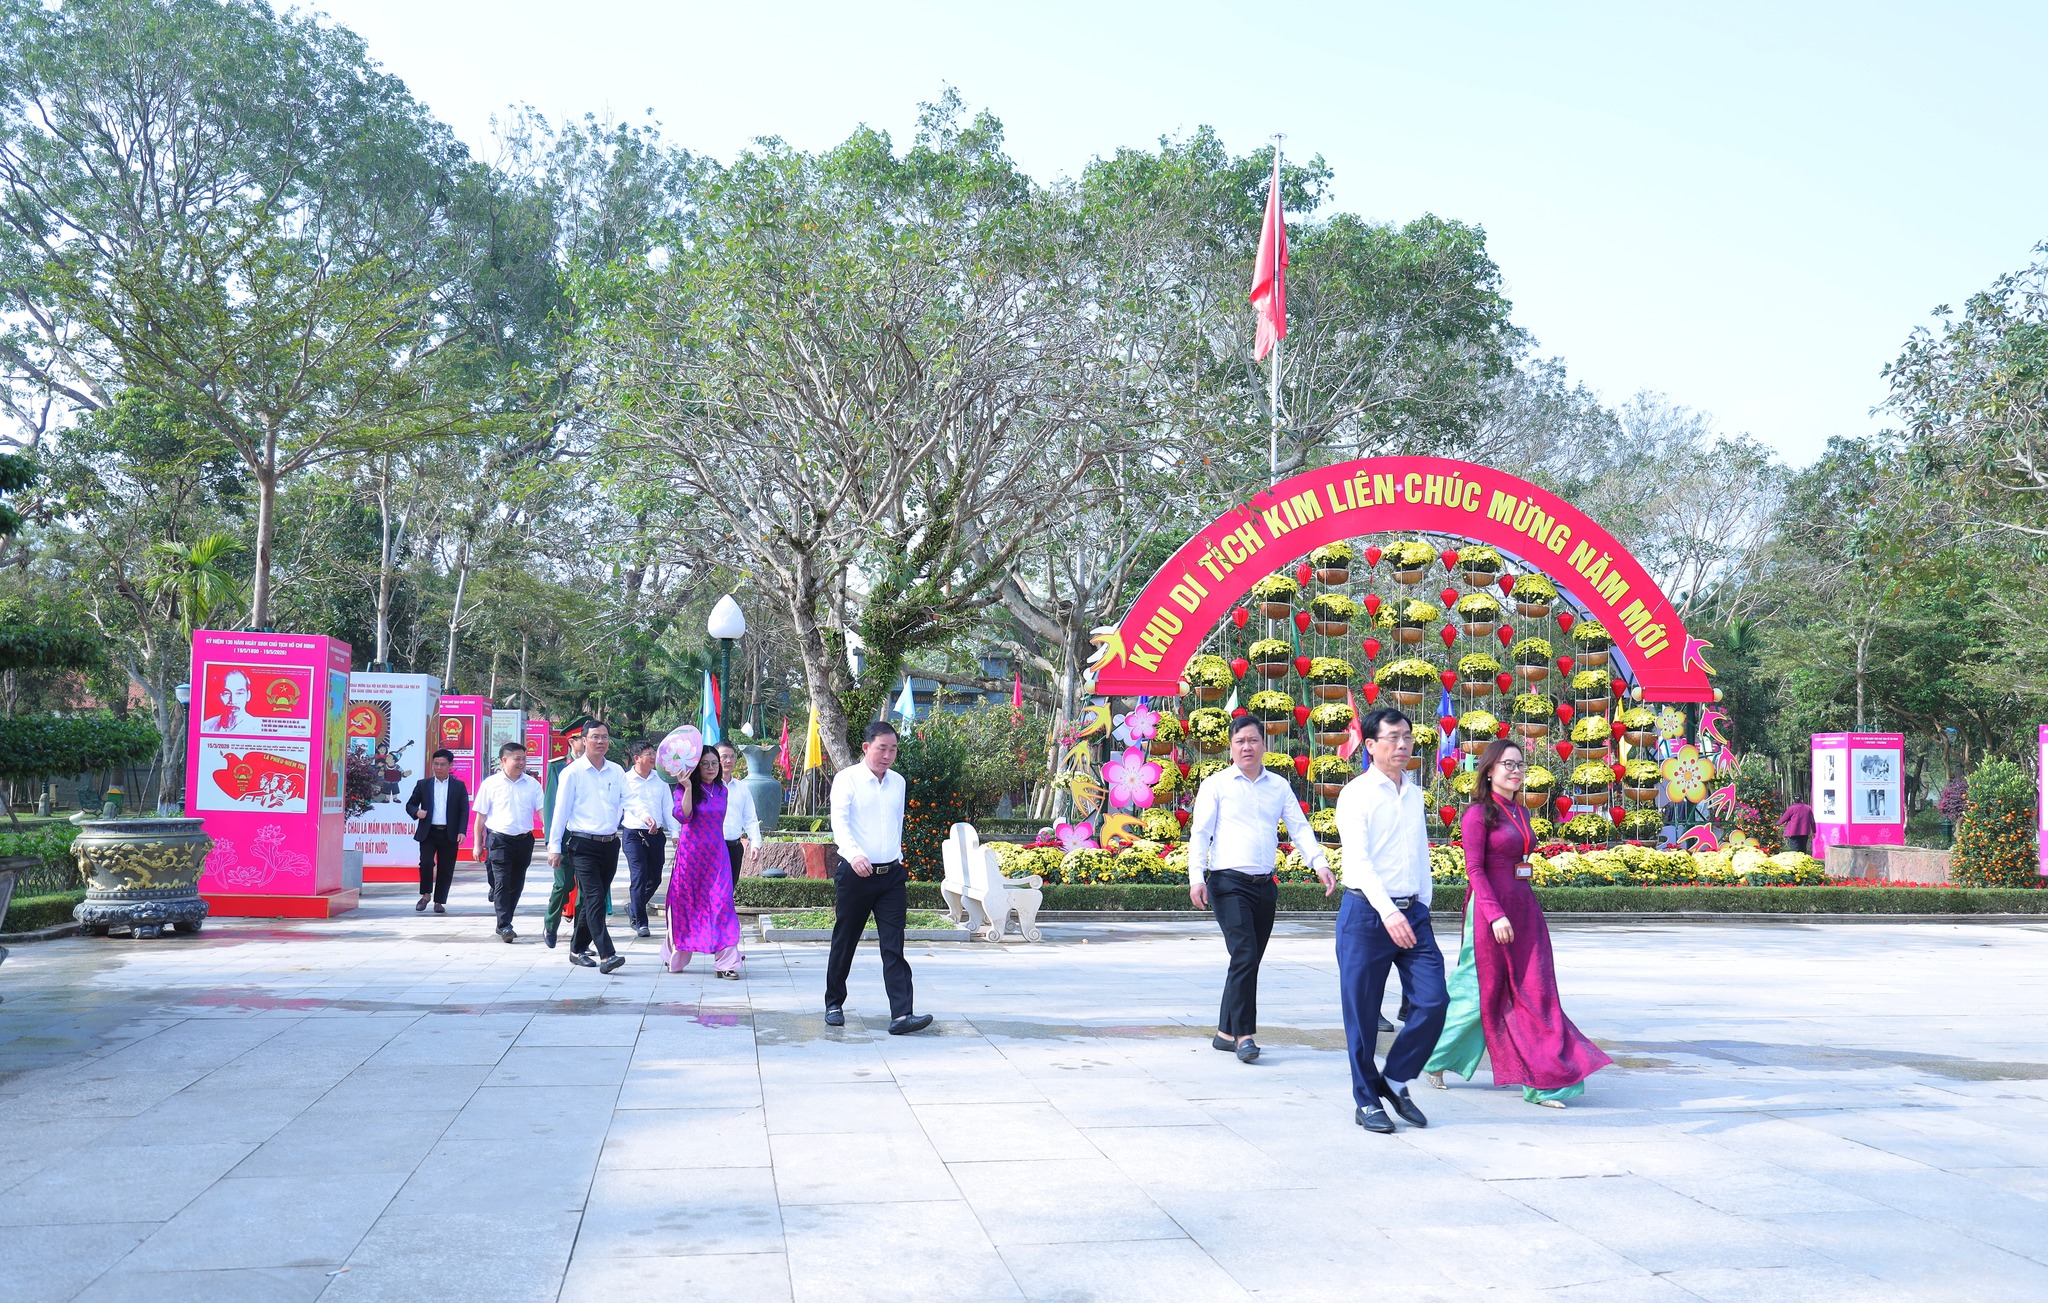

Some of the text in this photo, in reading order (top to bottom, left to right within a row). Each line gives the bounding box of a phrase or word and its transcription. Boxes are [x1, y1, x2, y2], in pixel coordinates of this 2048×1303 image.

[1128, 470, 1670, 673] KHU DI TÍCH KIM LIÊN CHÚC MỪNG NĂM MỚI
[381, 823, 391, 834] NON
